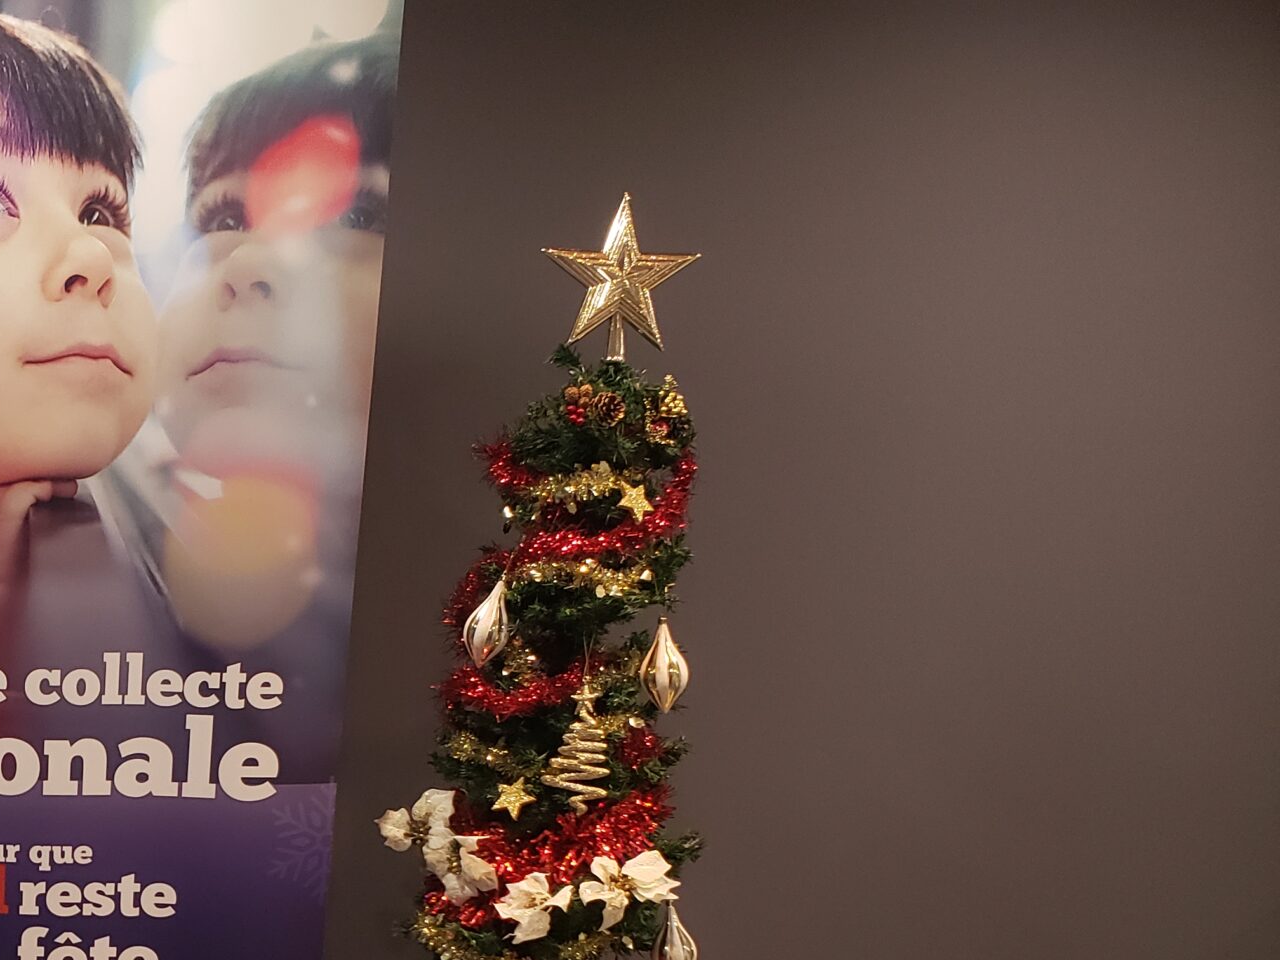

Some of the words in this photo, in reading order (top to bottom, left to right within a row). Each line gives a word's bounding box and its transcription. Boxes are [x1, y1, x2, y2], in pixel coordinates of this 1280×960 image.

[24, 652, 284, 709] collecte
[28, 843, 93, 871] que
[19, 873, 177, 917] reste
